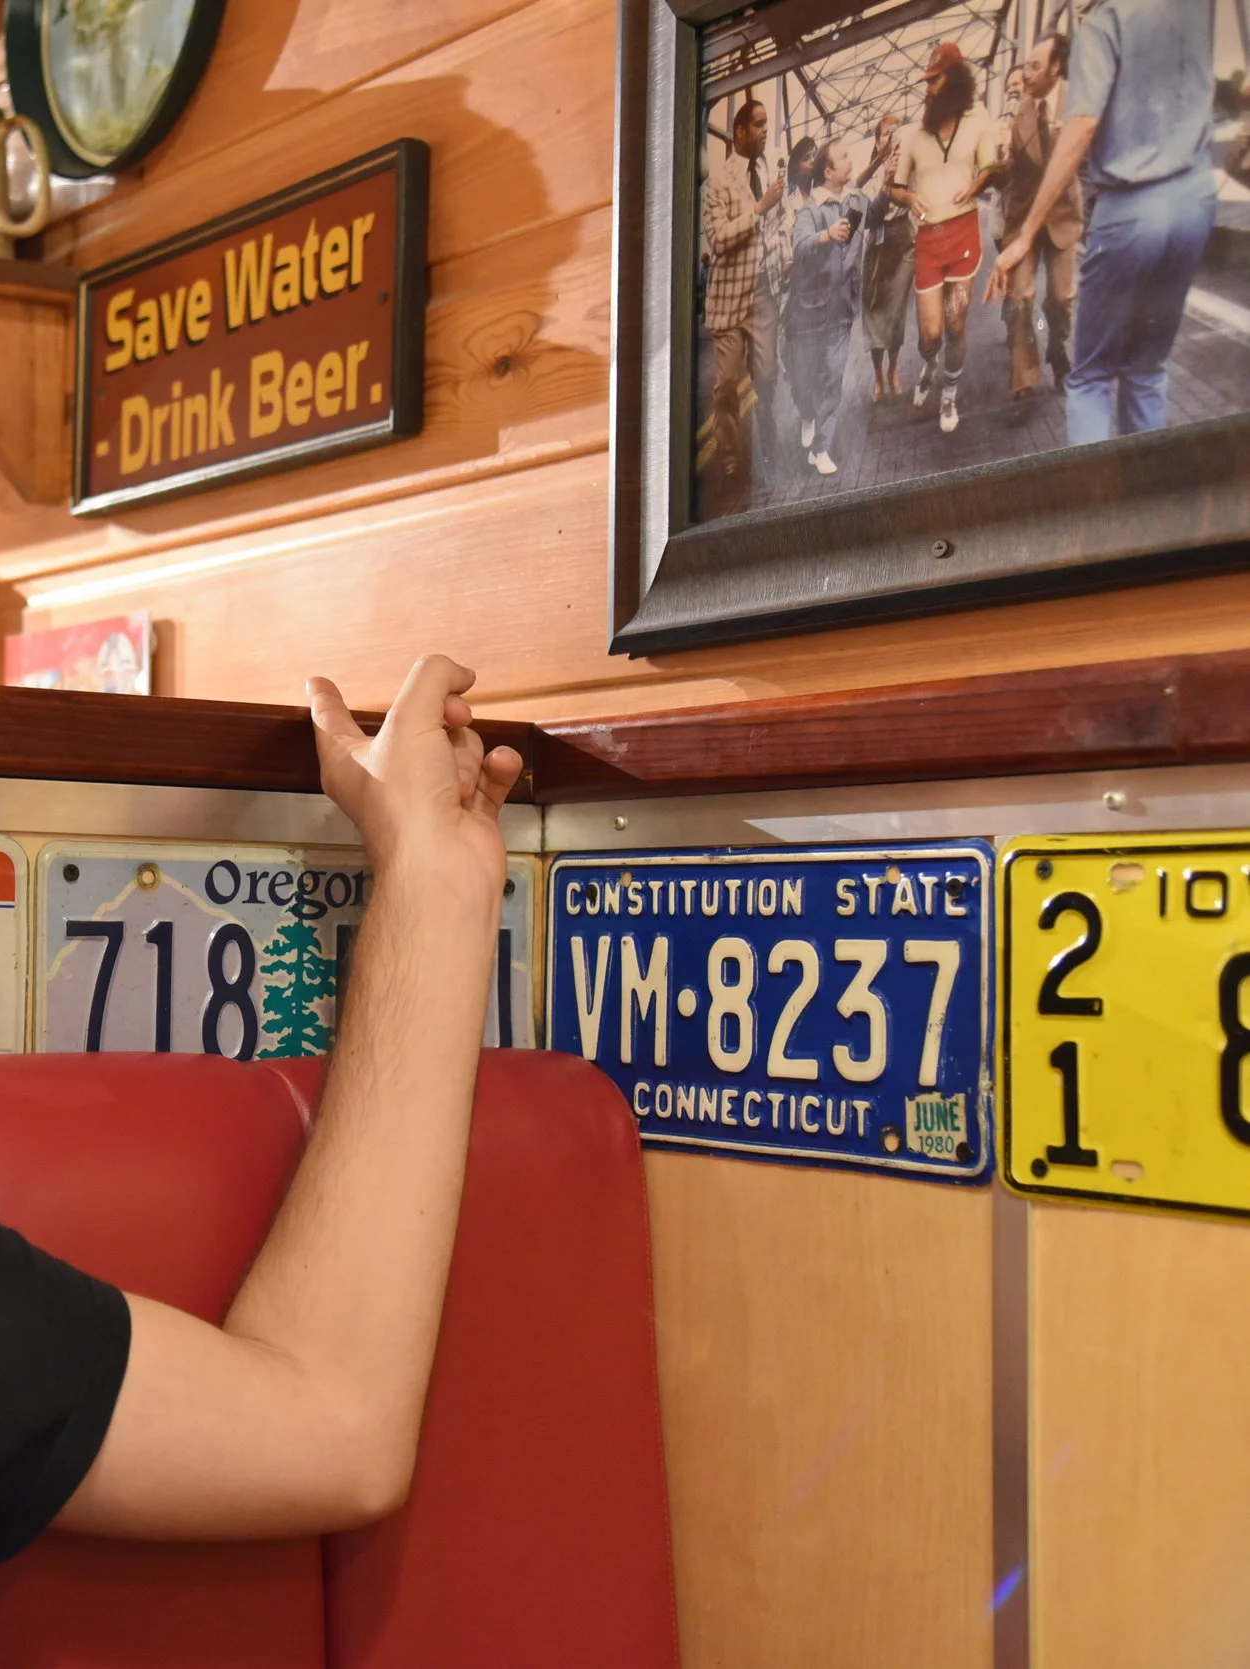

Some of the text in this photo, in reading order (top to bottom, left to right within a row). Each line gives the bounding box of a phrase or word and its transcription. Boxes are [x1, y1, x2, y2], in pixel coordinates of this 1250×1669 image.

[105, 212, 375, 374] Save Water
[249, 341, 383, 440] Beer.
[565, 872, 968, 918] CONSTITUTION STATE
[1157, 866, 1250, 919] IO
[65, 919, 259, 1062] 718
[633, 1082, 872, 1138] CONNECTICUT
[913, 1101, 962, 1132] JUNE
[918, 1135, 955, 1155] 1980
